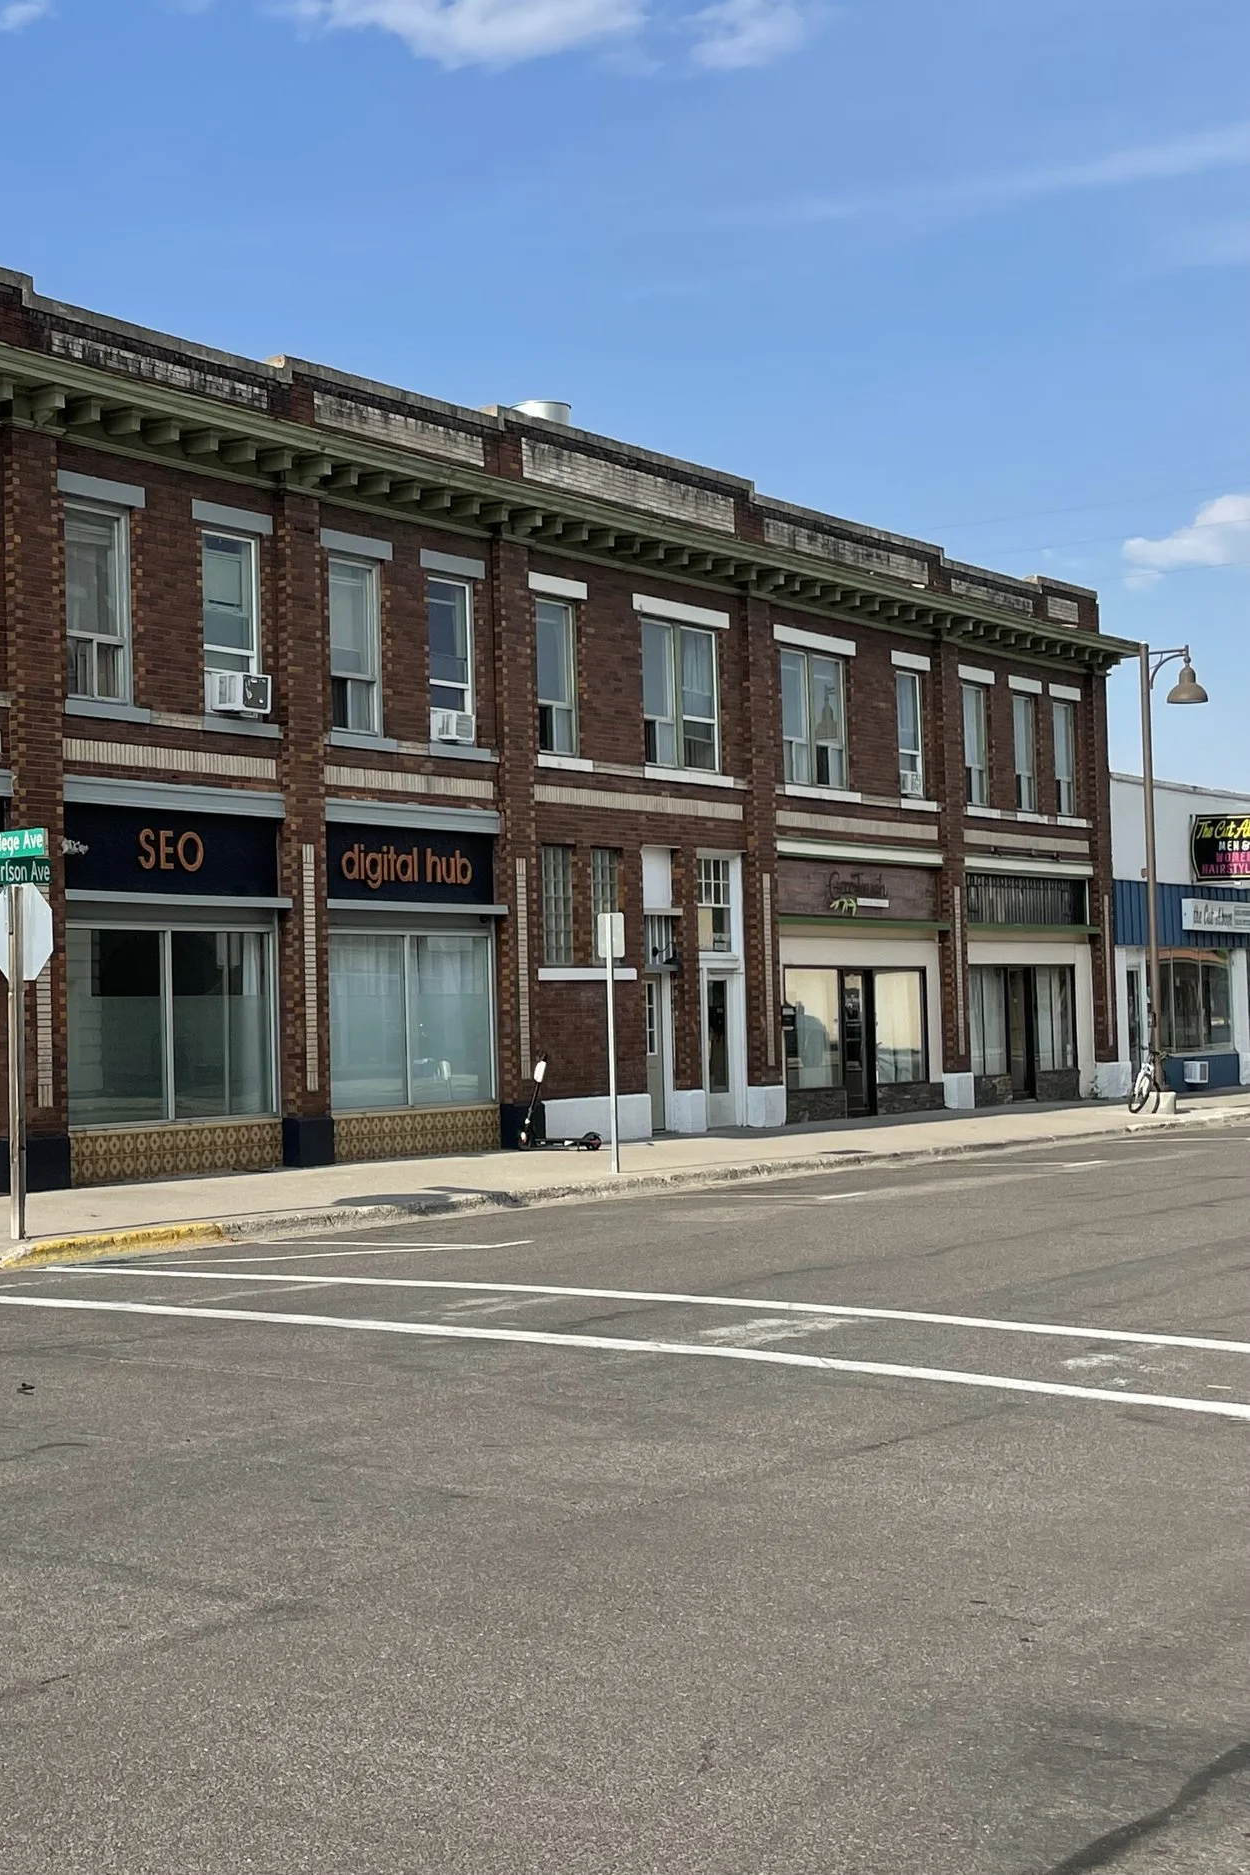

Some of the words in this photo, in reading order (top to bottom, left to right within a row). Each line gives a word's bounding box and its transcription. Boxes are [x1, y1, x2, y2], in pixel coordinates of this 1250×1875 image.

[1196, 820, 1213, 839] The
[1214, 820, 1236, 838] Cut
[22, 831, 43, 850] Ave
[138, 828, 204, 872] SEO
[1218, 840, 1239, 851] MEN
[1241, 840, 1250, 851] &
[30, 860, 50, 881] Ave
[341, 844, 419, 889] digital
[426, 848, 473, 886] hub
